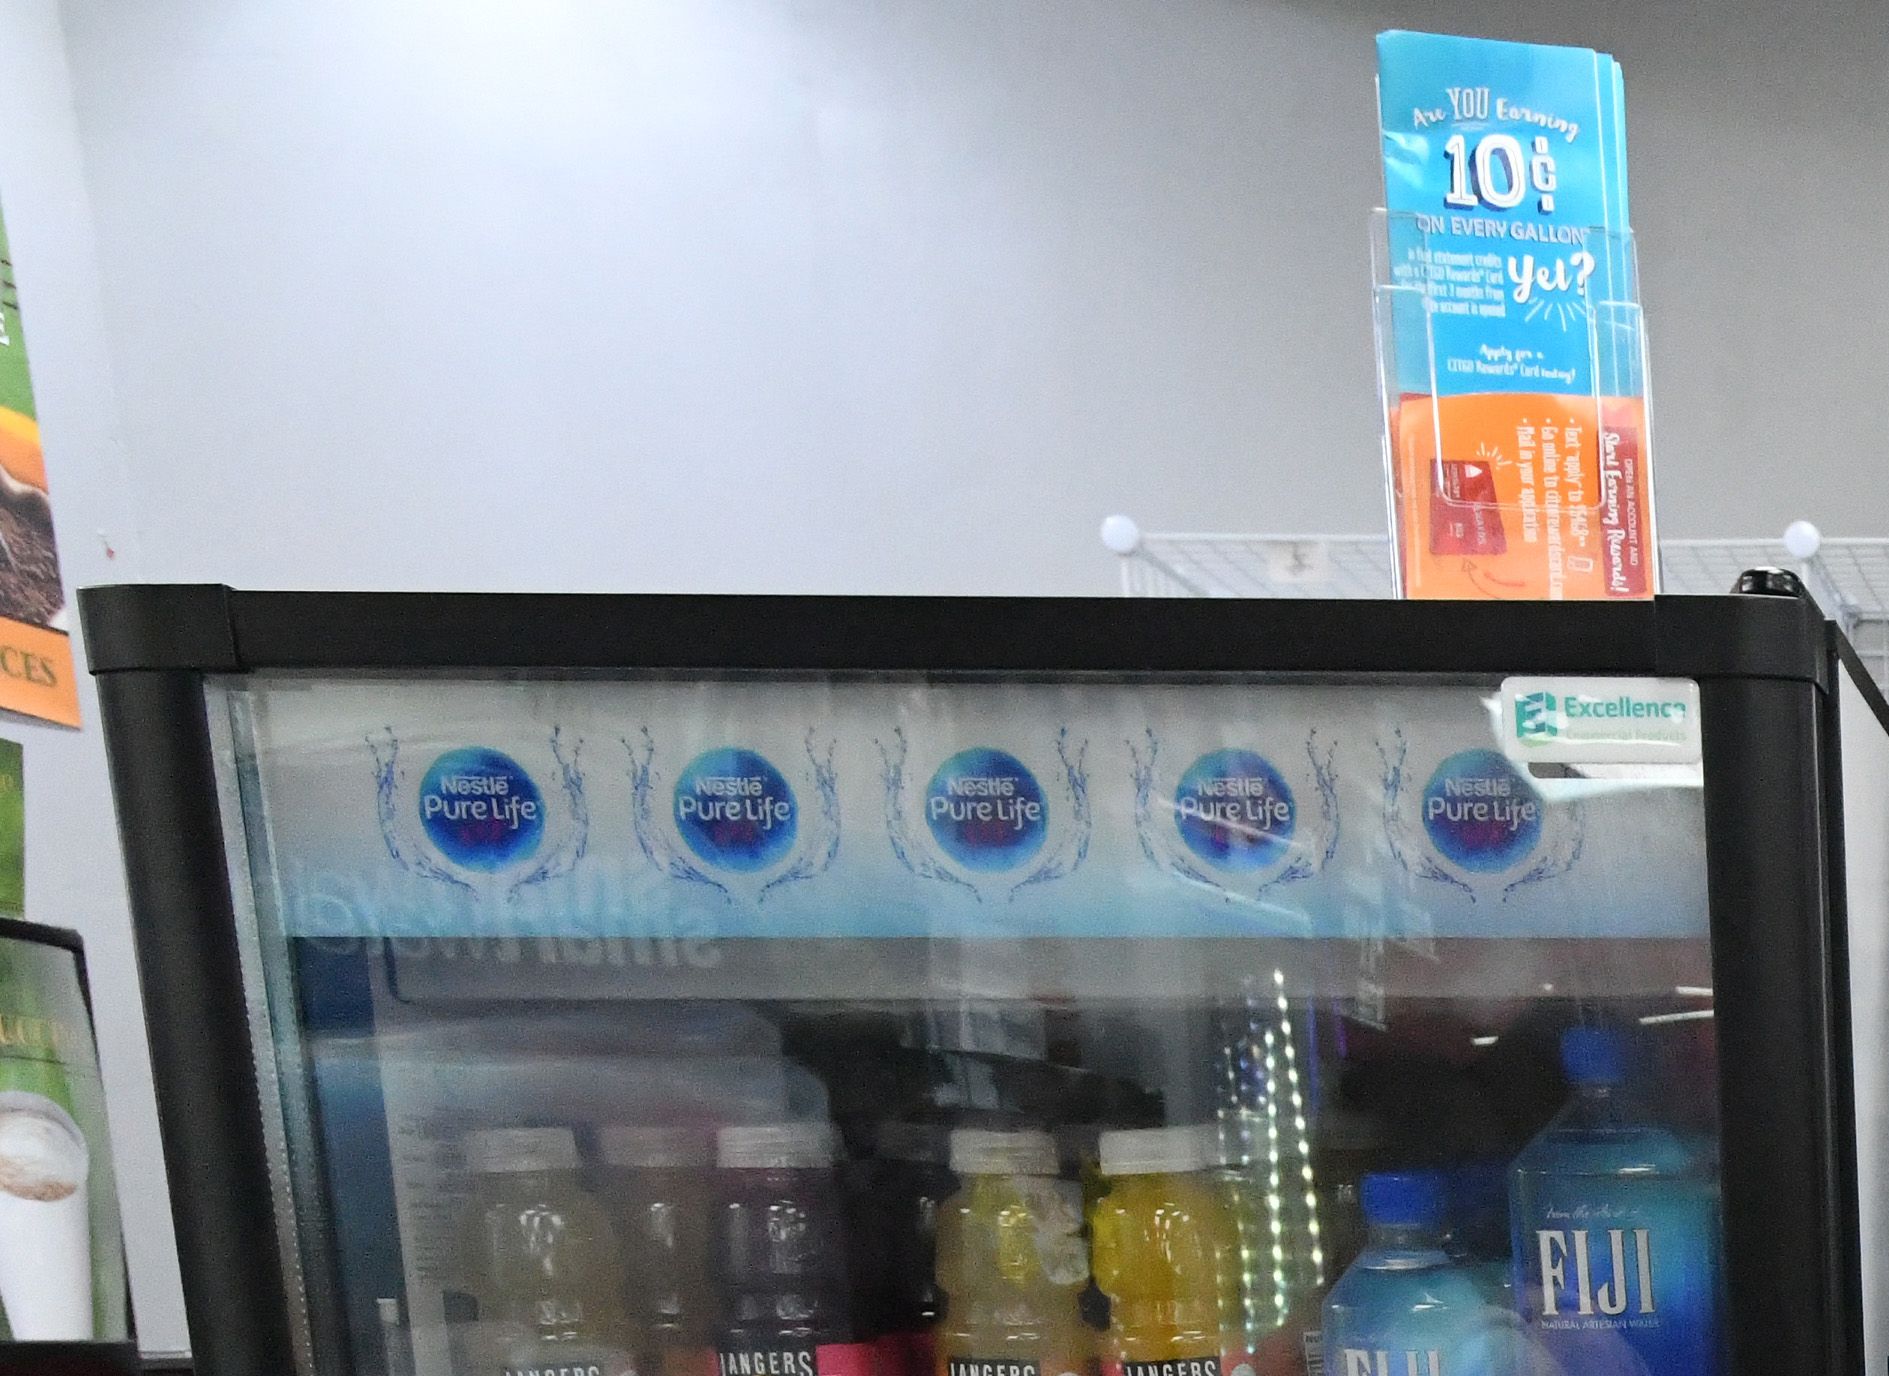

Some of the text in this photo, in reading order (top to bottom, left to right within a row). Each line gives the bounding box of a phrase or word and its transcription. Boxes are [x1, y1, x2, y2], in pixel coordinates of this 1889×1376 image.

[1413, 87, 1580, 144] Are YOU Earning
[1416, 213, 1444, 234] ON
[1451, 216, 1507, 237] EVERY
[1520, 364, 1540, 376] Card
[424, 795, 537, 829] Pure Life
[680, 796, 790, 830] Pure Life
[930, 796, 1041, 830] Pure Life
[1181, 796, 1289, 830] Pure Life
[1428, 797, 1537, 831] Pure Life
[1536, 1229, 1656, 1316] FIJI
